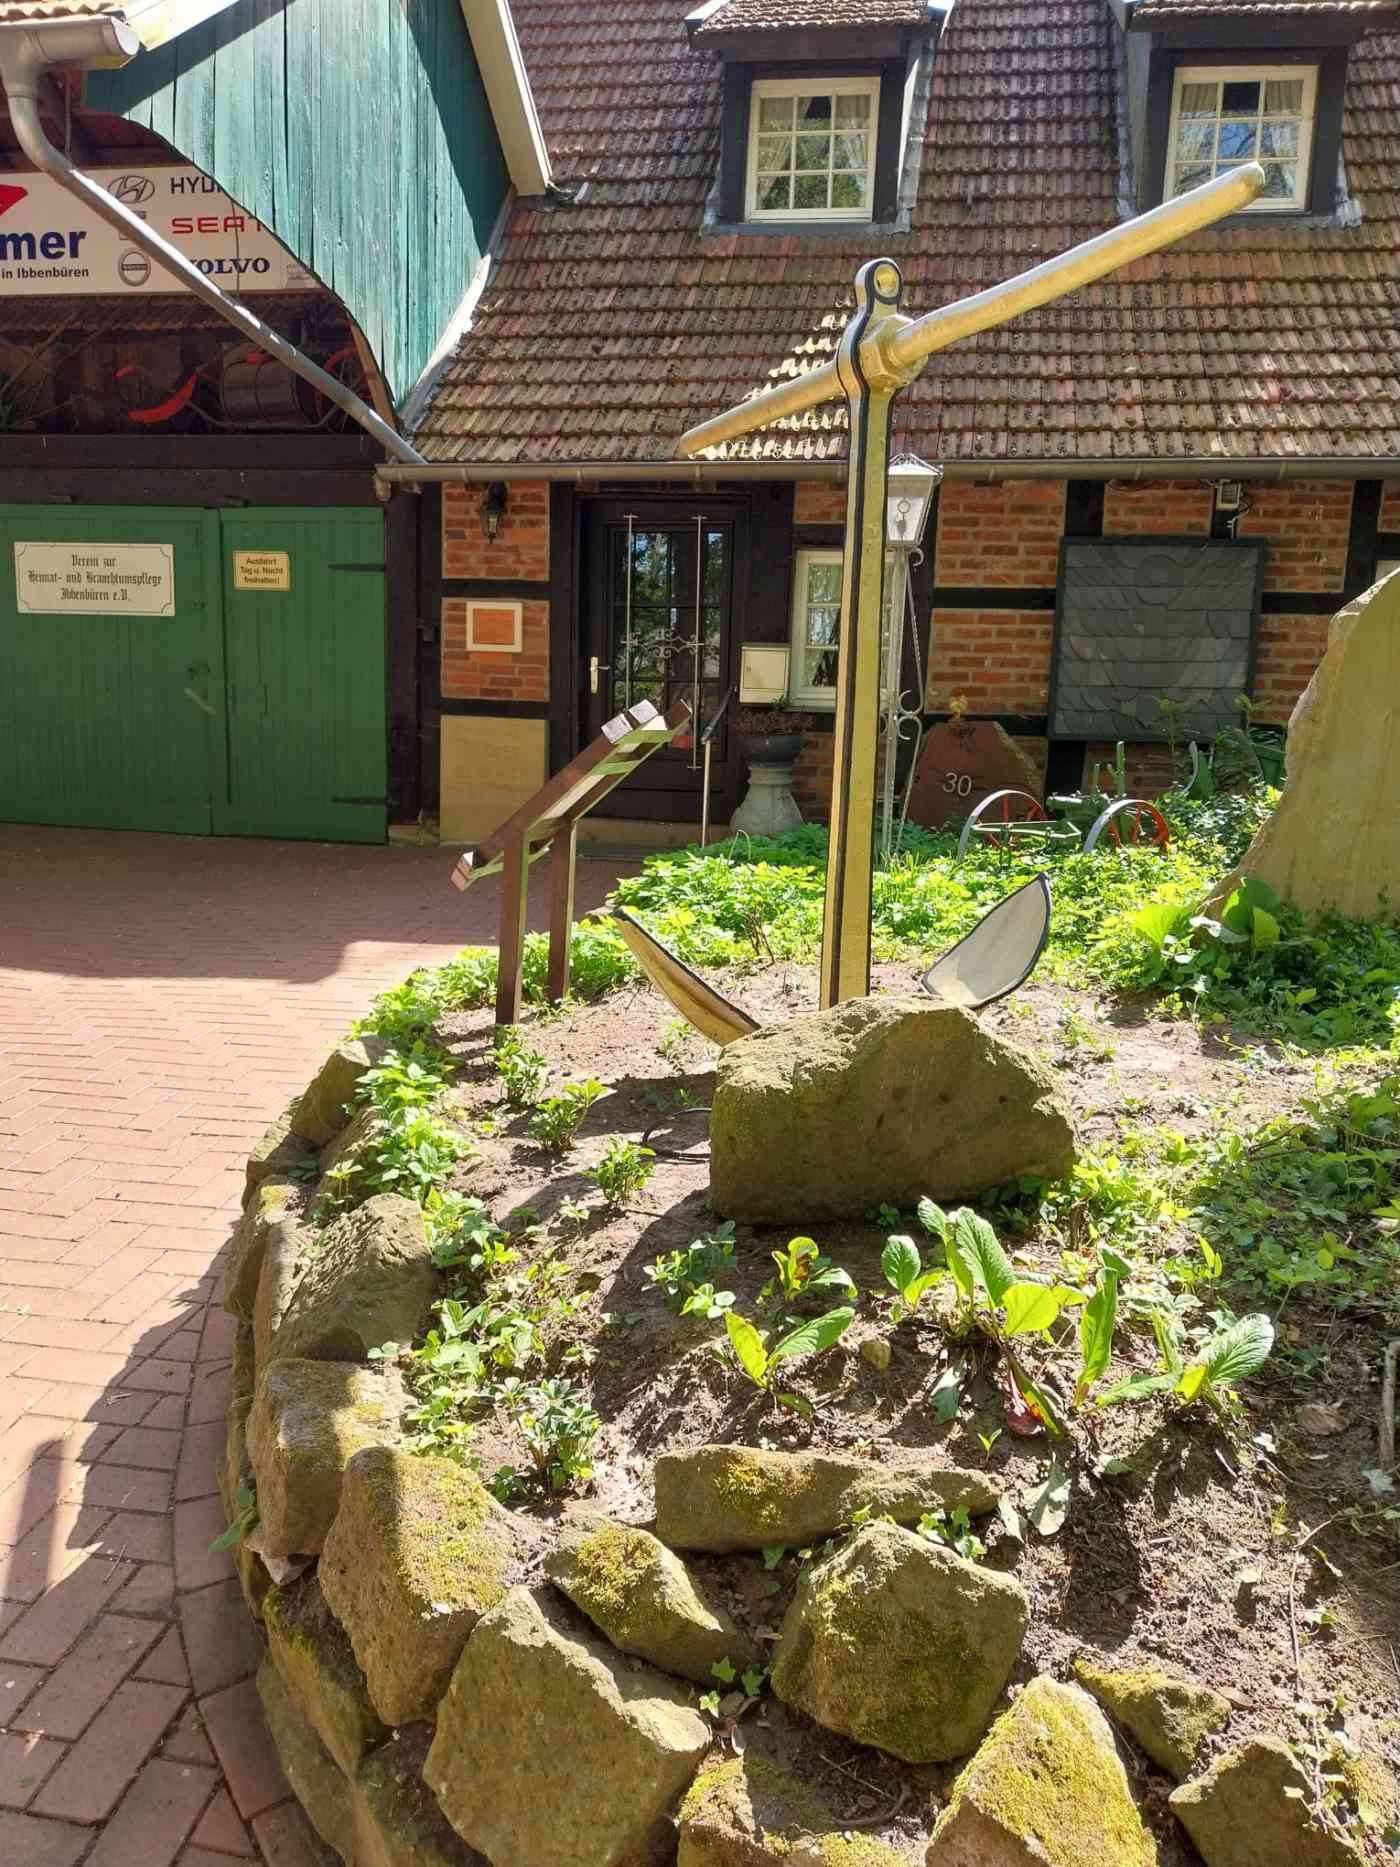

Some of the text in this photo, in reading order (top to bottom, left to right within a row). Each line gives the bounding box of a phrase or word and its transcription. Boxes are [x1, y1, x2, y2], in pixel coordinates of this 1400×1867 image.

[0, 231, 87, 260] mer
[1, 266, 89, 279] in Ibbenbüren
[71, 554, 117, 569] Verein zur
[28, 570, 162, 587] Heimat- und Brauchtumspflege
[60, 587, 109, 601] Ibbenbüren
[942, 772, 972, 797] 30
